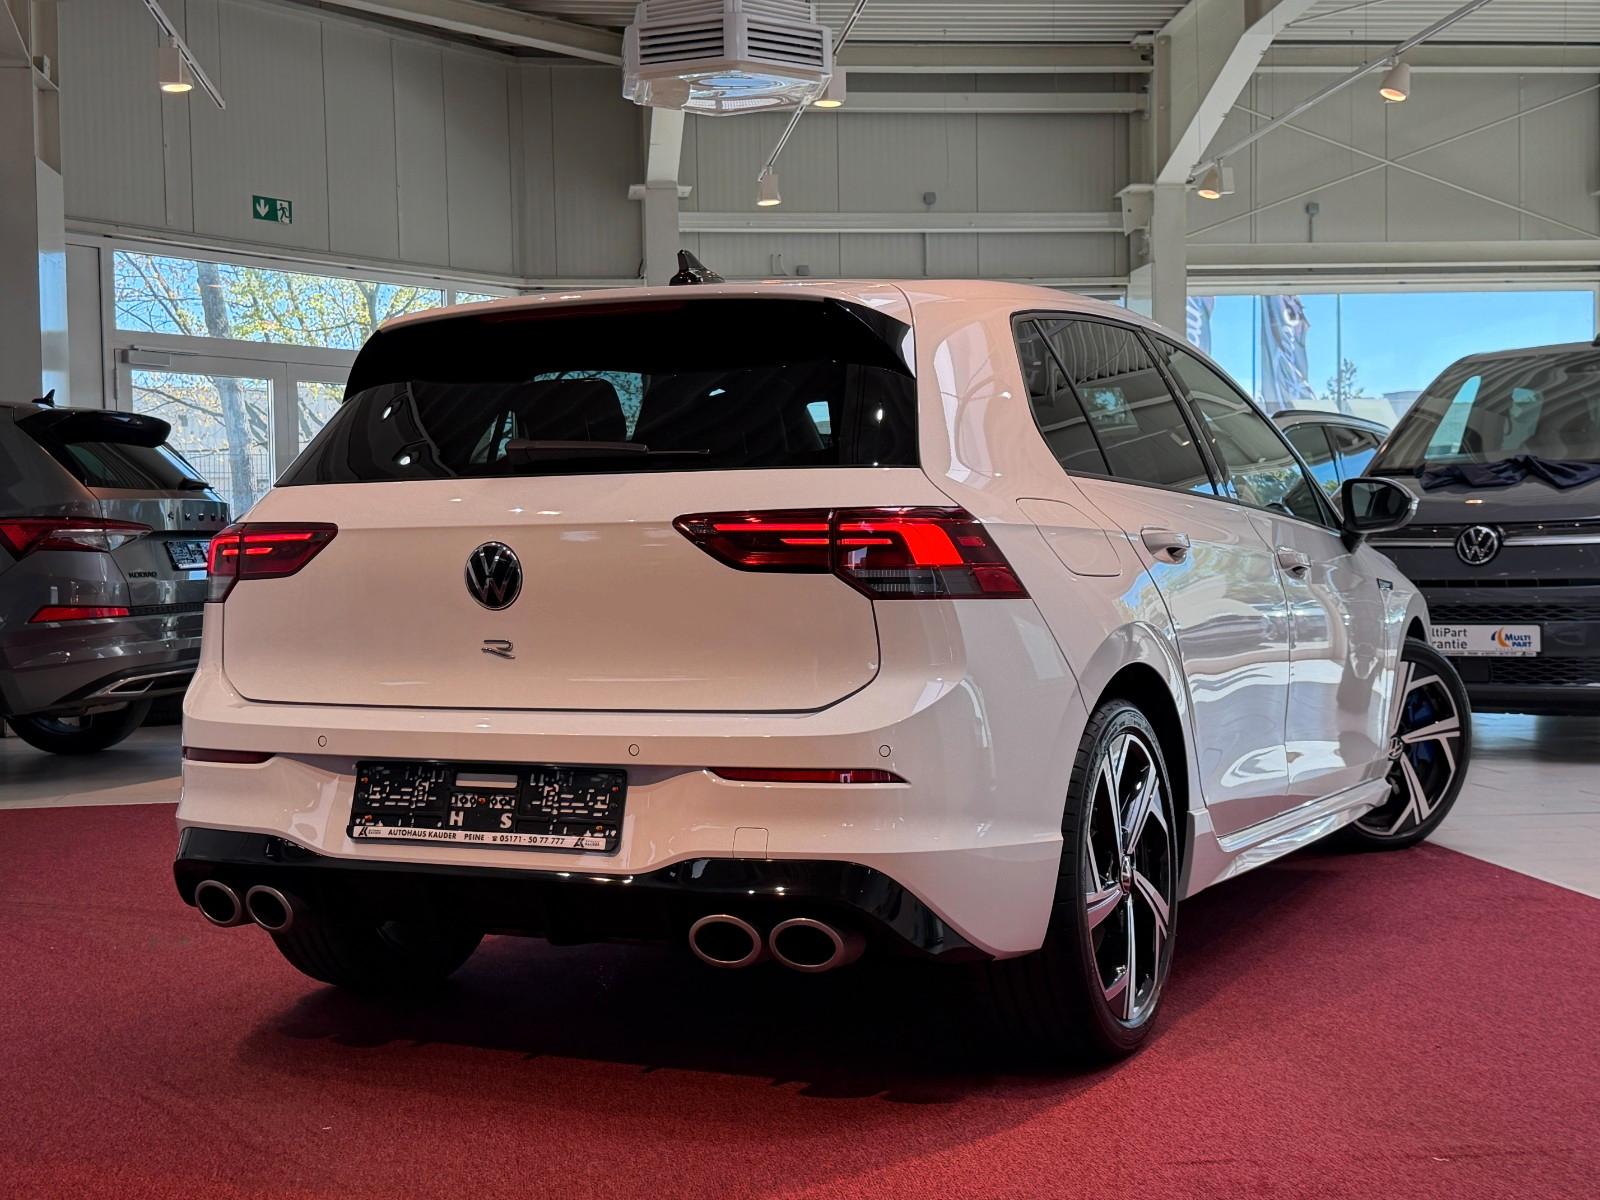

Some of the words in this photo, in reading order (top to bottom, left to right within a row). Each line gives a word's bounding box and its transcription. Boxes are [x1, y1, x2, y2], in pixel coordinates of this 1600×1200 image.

[1431, 627, 1468, 638] ltiPart
[1431, 638, 1468, 650] rantie
[449, 810, 464, 827] H
[499, 812, 513, 829] S
[388, 828, 427, 838] AUTOHAUS
[427, 830, 457, 840] KAUDER
[463, 833, 485, 841] PEINE
[500, 835, 522, 843] 05171
[550, 837, 566, 845] 777
